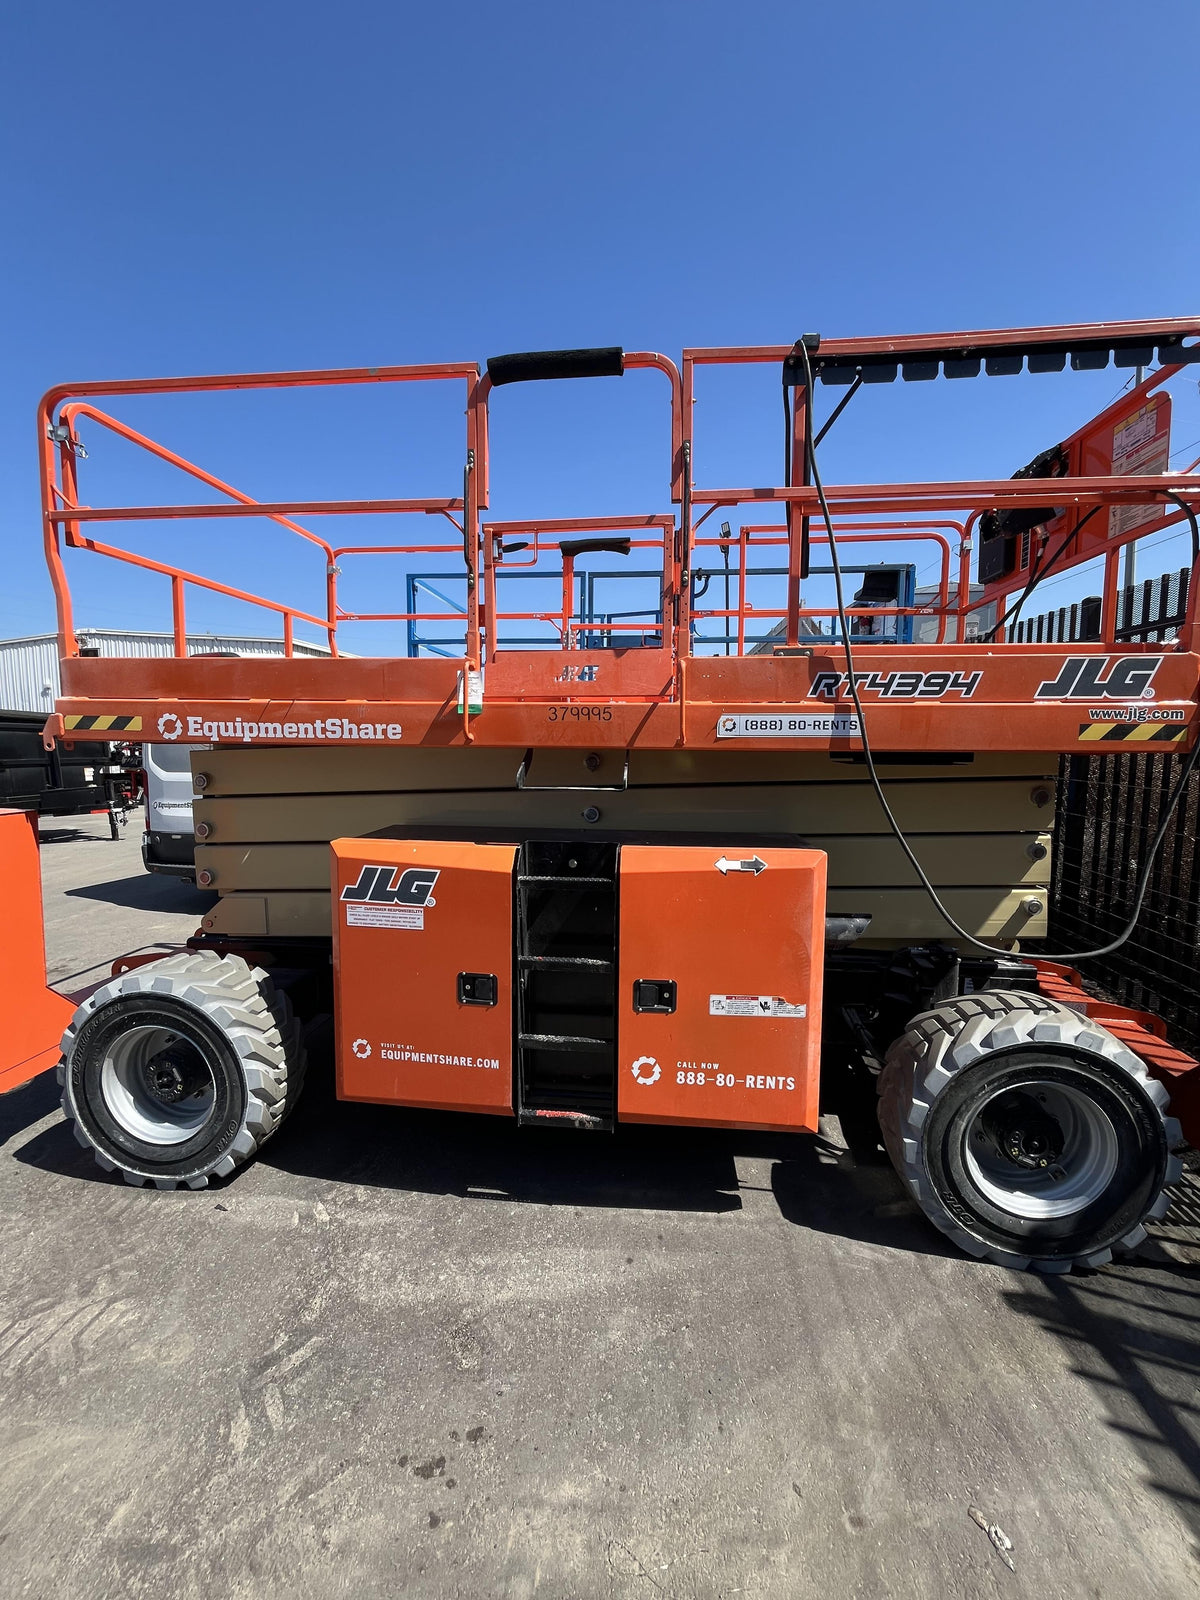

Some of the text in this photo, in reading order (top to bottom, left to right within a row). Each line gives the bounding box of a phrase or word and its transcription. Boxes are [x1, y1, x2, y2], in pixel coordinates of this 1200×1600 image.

[807, 671, 984, 698] RT4394
[1034, 656, 1164, 699] JLG
[548, 706, 612, 721] 379995
[1089, 707, 1184, 722] www.jlg.com
[187, 716, 402, 742] EquipmentShare
[744, 720, 858, 731] (888) 80-RENTS
[340, 864, 441, 907] JLG
[381, 1050, 500, 1069] EQUIPMENTSHARE.COM
[676, 1071, 796, 1091] 888-80-RENTS
